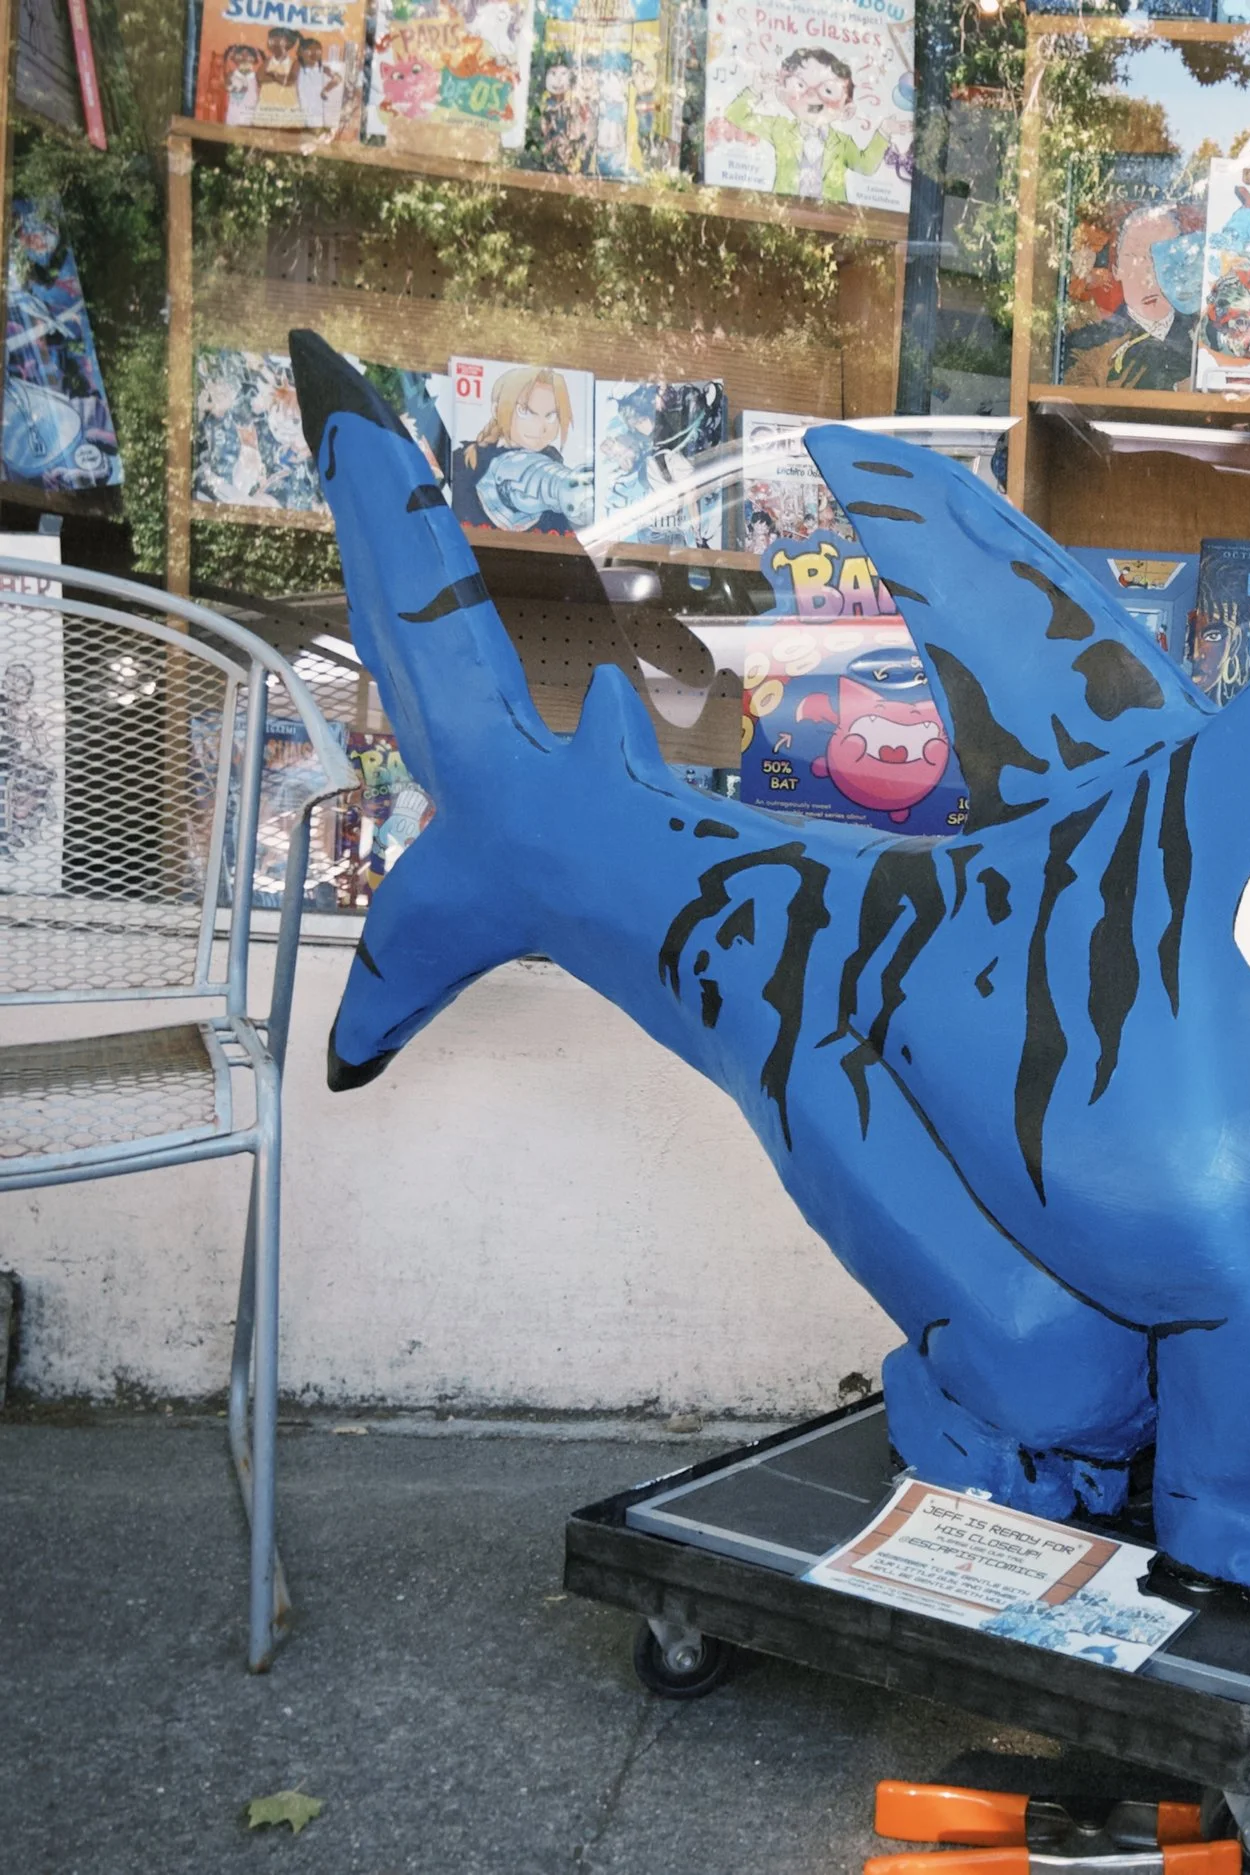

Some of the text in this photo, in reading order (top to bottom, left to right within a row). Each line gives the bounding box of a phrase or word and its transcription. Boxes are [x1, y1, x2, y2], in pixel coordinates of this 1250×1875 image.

[226, 0, 346, 26] SUMMER
[756, 8, 882, 47] Pink Glasses
[456, 377, 482, 399] 01
[762, 760, 792, 774] 50%
[770, 777, 799, 790] BAT
[923, 1505, 1076, 1557] JEFF IS READY FOR
[934, 1523, 1043, 1560] HIS CLOSEUP!
[898, 1534, 1049, 1580] @ESCAPISTCOMICS
[896, 1563, 935, 1580] LITTLE
